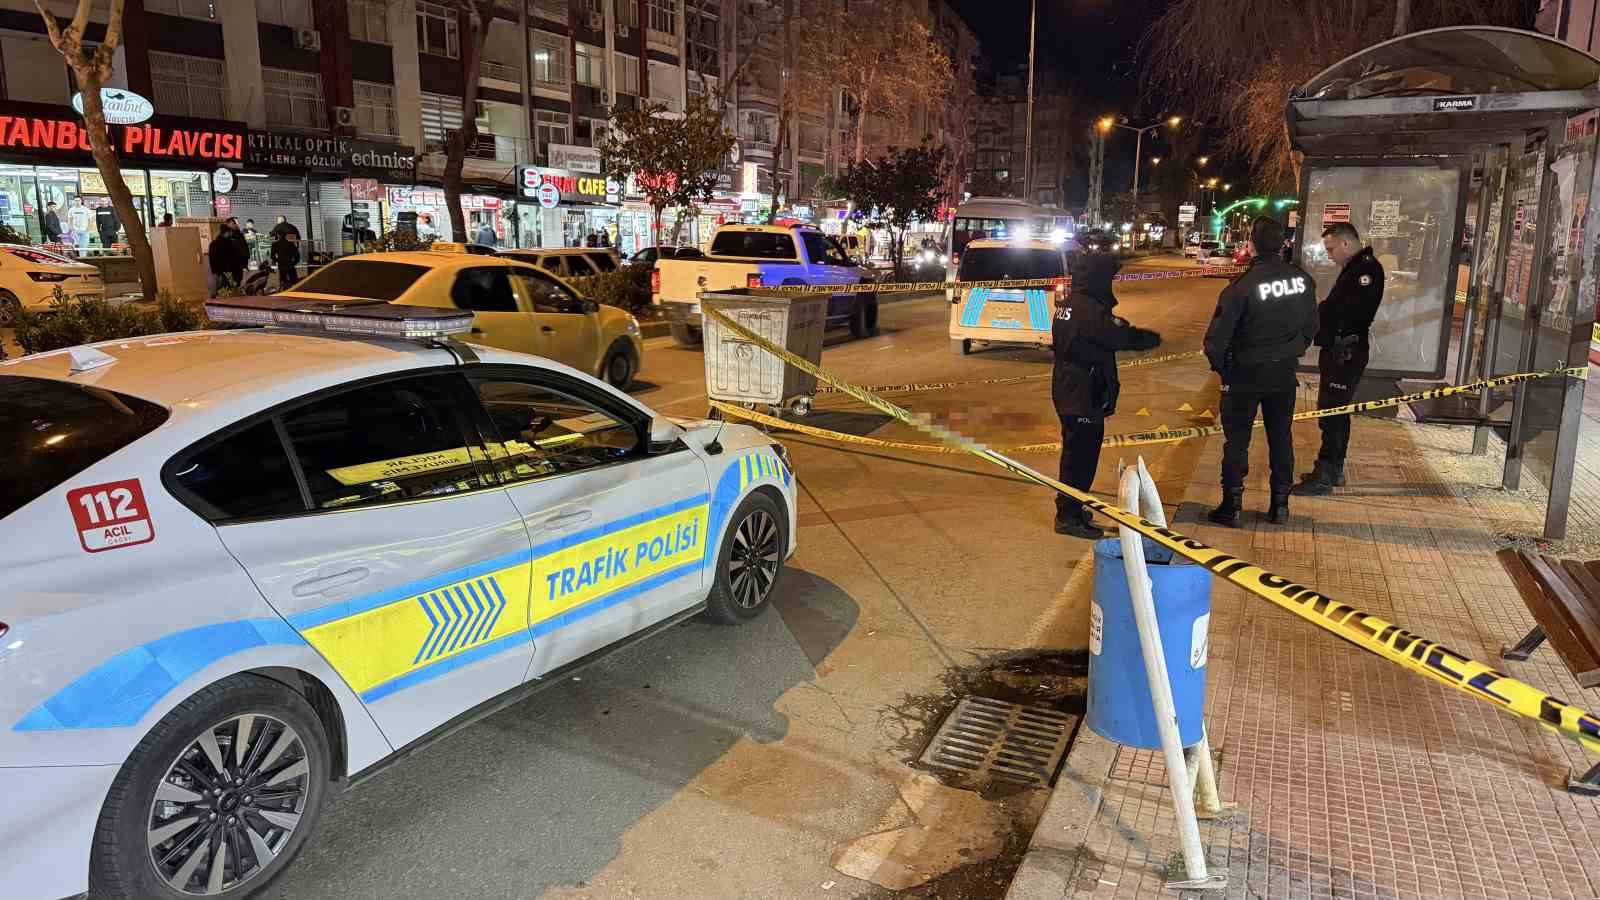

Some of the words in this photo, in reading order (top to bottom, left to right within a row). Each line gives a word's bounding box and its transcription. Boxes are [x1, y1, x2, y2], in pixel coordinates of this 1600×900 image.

[1439, 100, 1473, 108] KARMA
[125, 122, 243, 160] PİLAVCISI
[305, 137, 347, 153] OPTİK
[352, 151, 414, 169] echnics
[578, 177, 606, 196] CAFE
[1258, 277, 1306, 301] POLIS
[80, 487, 138, 524] 112
[546, 546, 629, 601] TRAFİK
[634, 517, 699, 568] POLİSİ
